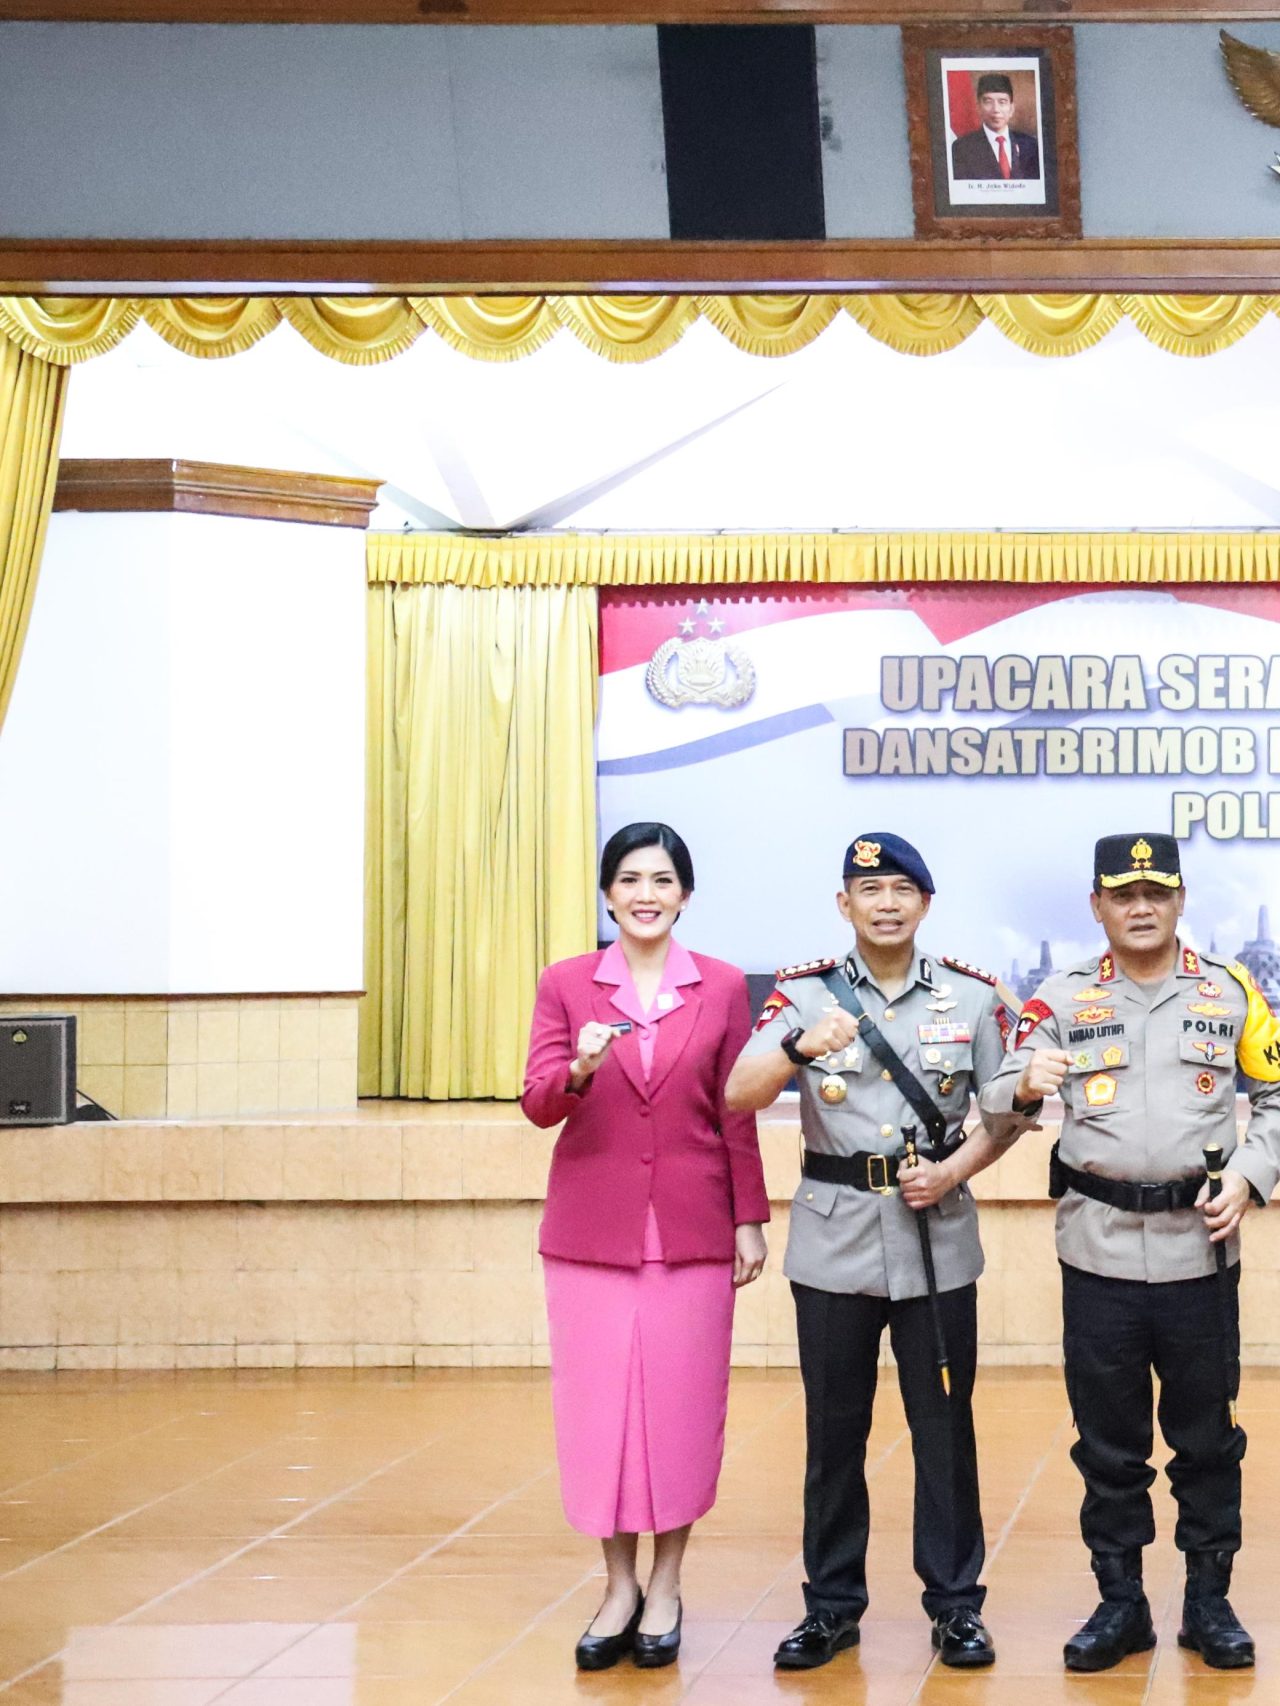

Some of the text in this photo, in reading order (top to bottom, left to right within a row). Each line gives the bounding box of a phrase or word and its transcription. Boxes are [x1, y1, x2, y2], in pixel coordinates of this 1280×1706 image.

[880, 654, 1147, 713] UPACARA
[842, 726, 1257, 778] DANSATBRIMOB
[1183, 1020, 1234, 1037] POLRI
